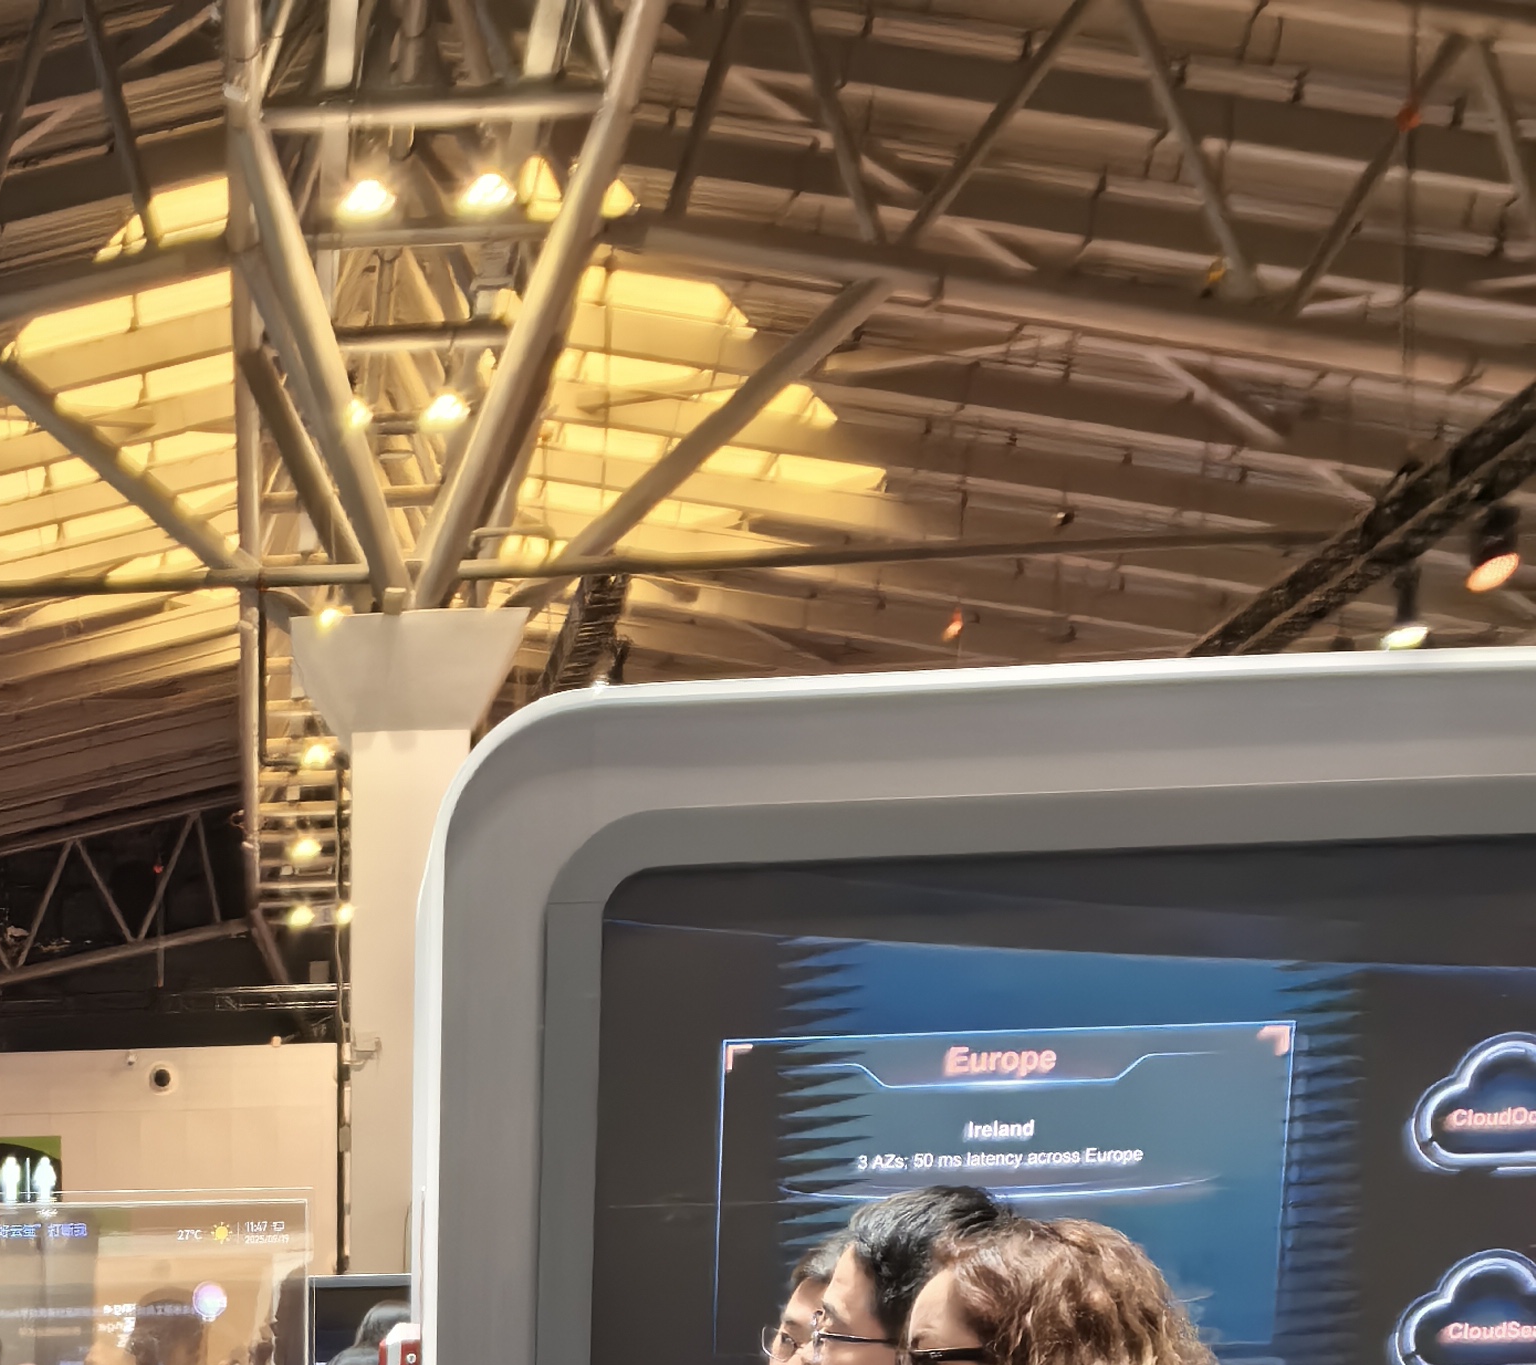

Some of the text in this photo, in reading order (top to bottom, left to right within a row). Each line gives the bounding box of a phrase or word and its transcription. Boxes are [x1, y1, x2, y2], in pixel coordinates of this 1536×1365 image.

[943, 1046, 1057, 1077] Europe
[966, 1120, 1035, 1140] Ireland
[858, 1147, 1144, 1170] 3 AZs; 50 ms latency across Europe
